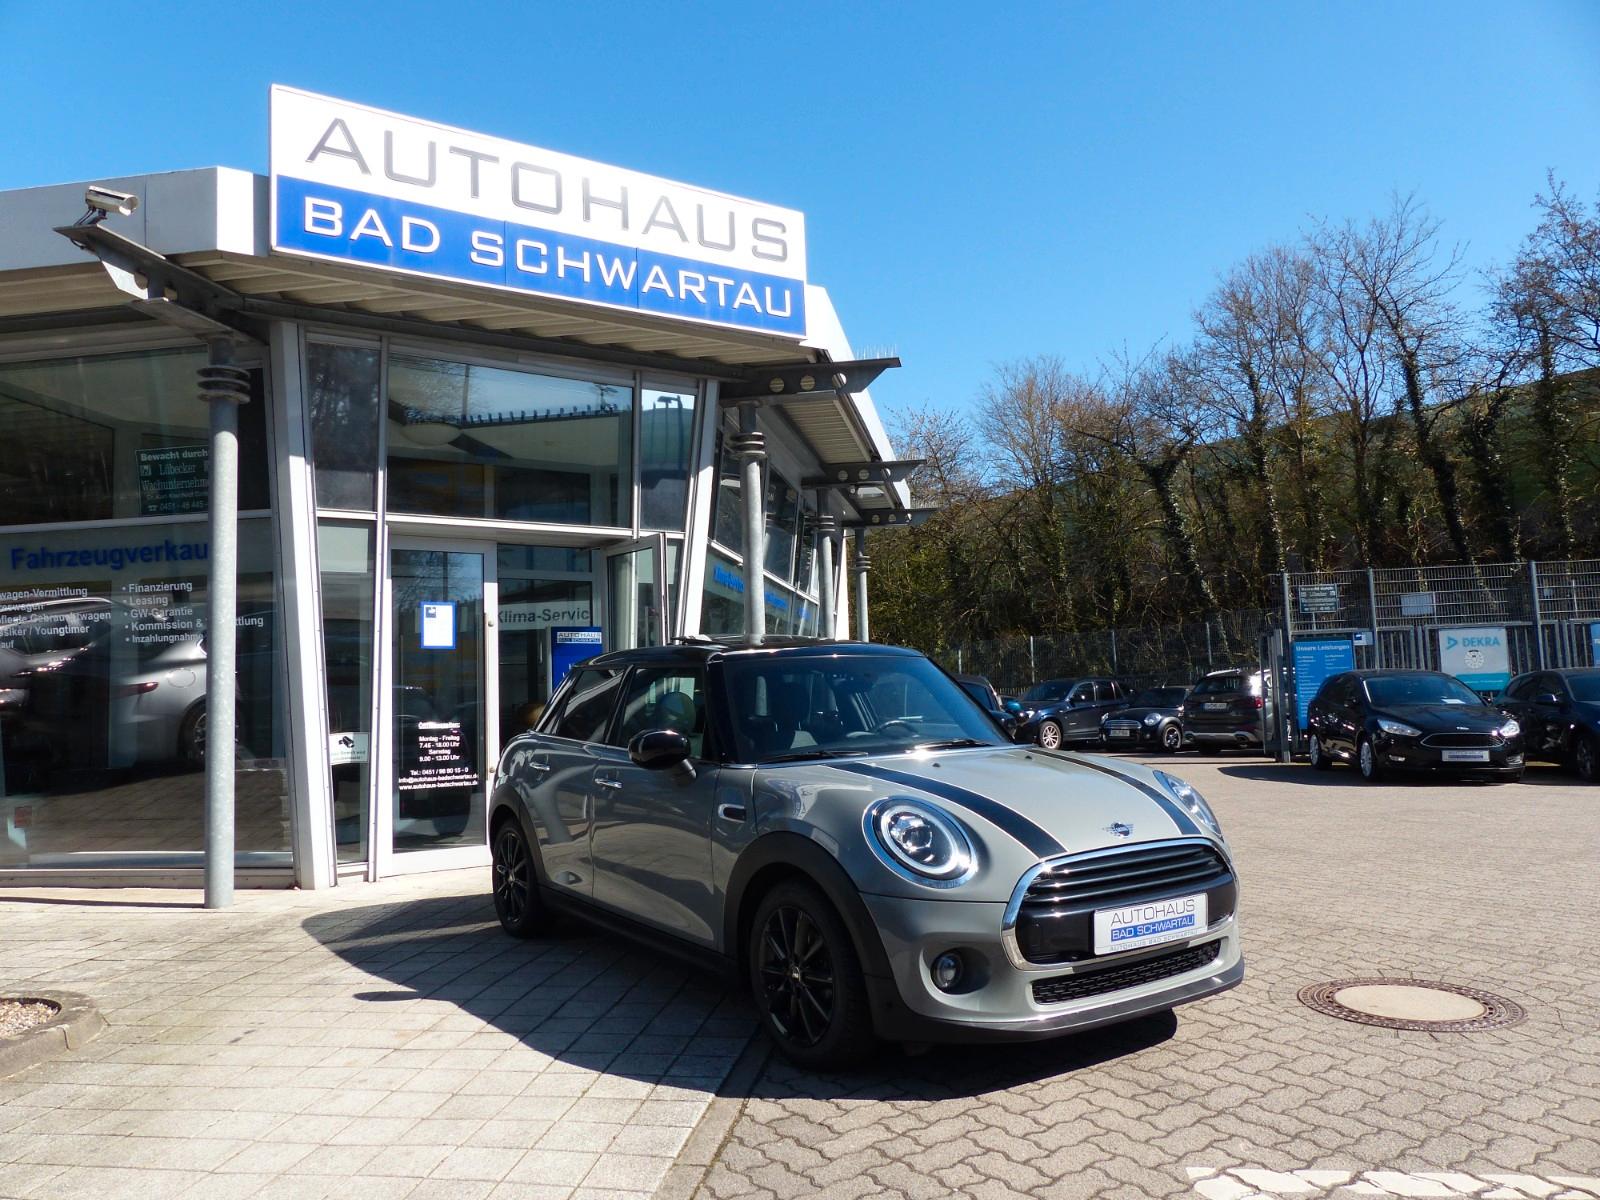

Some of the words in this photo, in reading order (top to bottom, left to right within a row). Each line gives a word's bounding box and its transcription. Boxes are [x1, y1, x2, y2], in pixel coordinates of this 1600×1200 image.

[306, 118, 789, 263] AUTOHAUS
[303, 197, 440, 254] BAD
[470, 231, 792, 319] SCHWARTAU
[140, 451, 180, 461] Bewacht
[182, 448, 208, 459] durch
[141, 479, 208, 491] Wachunternehm
[11, 539, 208, 570] Fahrzeugverkau
[128, 582, 193, 593] Finanzierung
[129, 596, 169, 606] Leasing
[130, 607, 193, 619] GW-Garantie
[498, 608, 590, 624] Klima-Servic
[35, 625, 90, 637] Youngtimer
[131, 620, 193, 631] Kommission
[132, 633, 204, 643] Inzahlungnahme
[1462, 636, 1501, 647] DEKRA
[1110, 899, 1196, 927] AUTOHAUS
[1112, 927, 1135, 940] BAD
[1136, 915, 1195, 936] SCHWARTAU
[1110, 940, 1147, 952] AUTOHAUS
[1148, 936, 1162, 945] BAD
